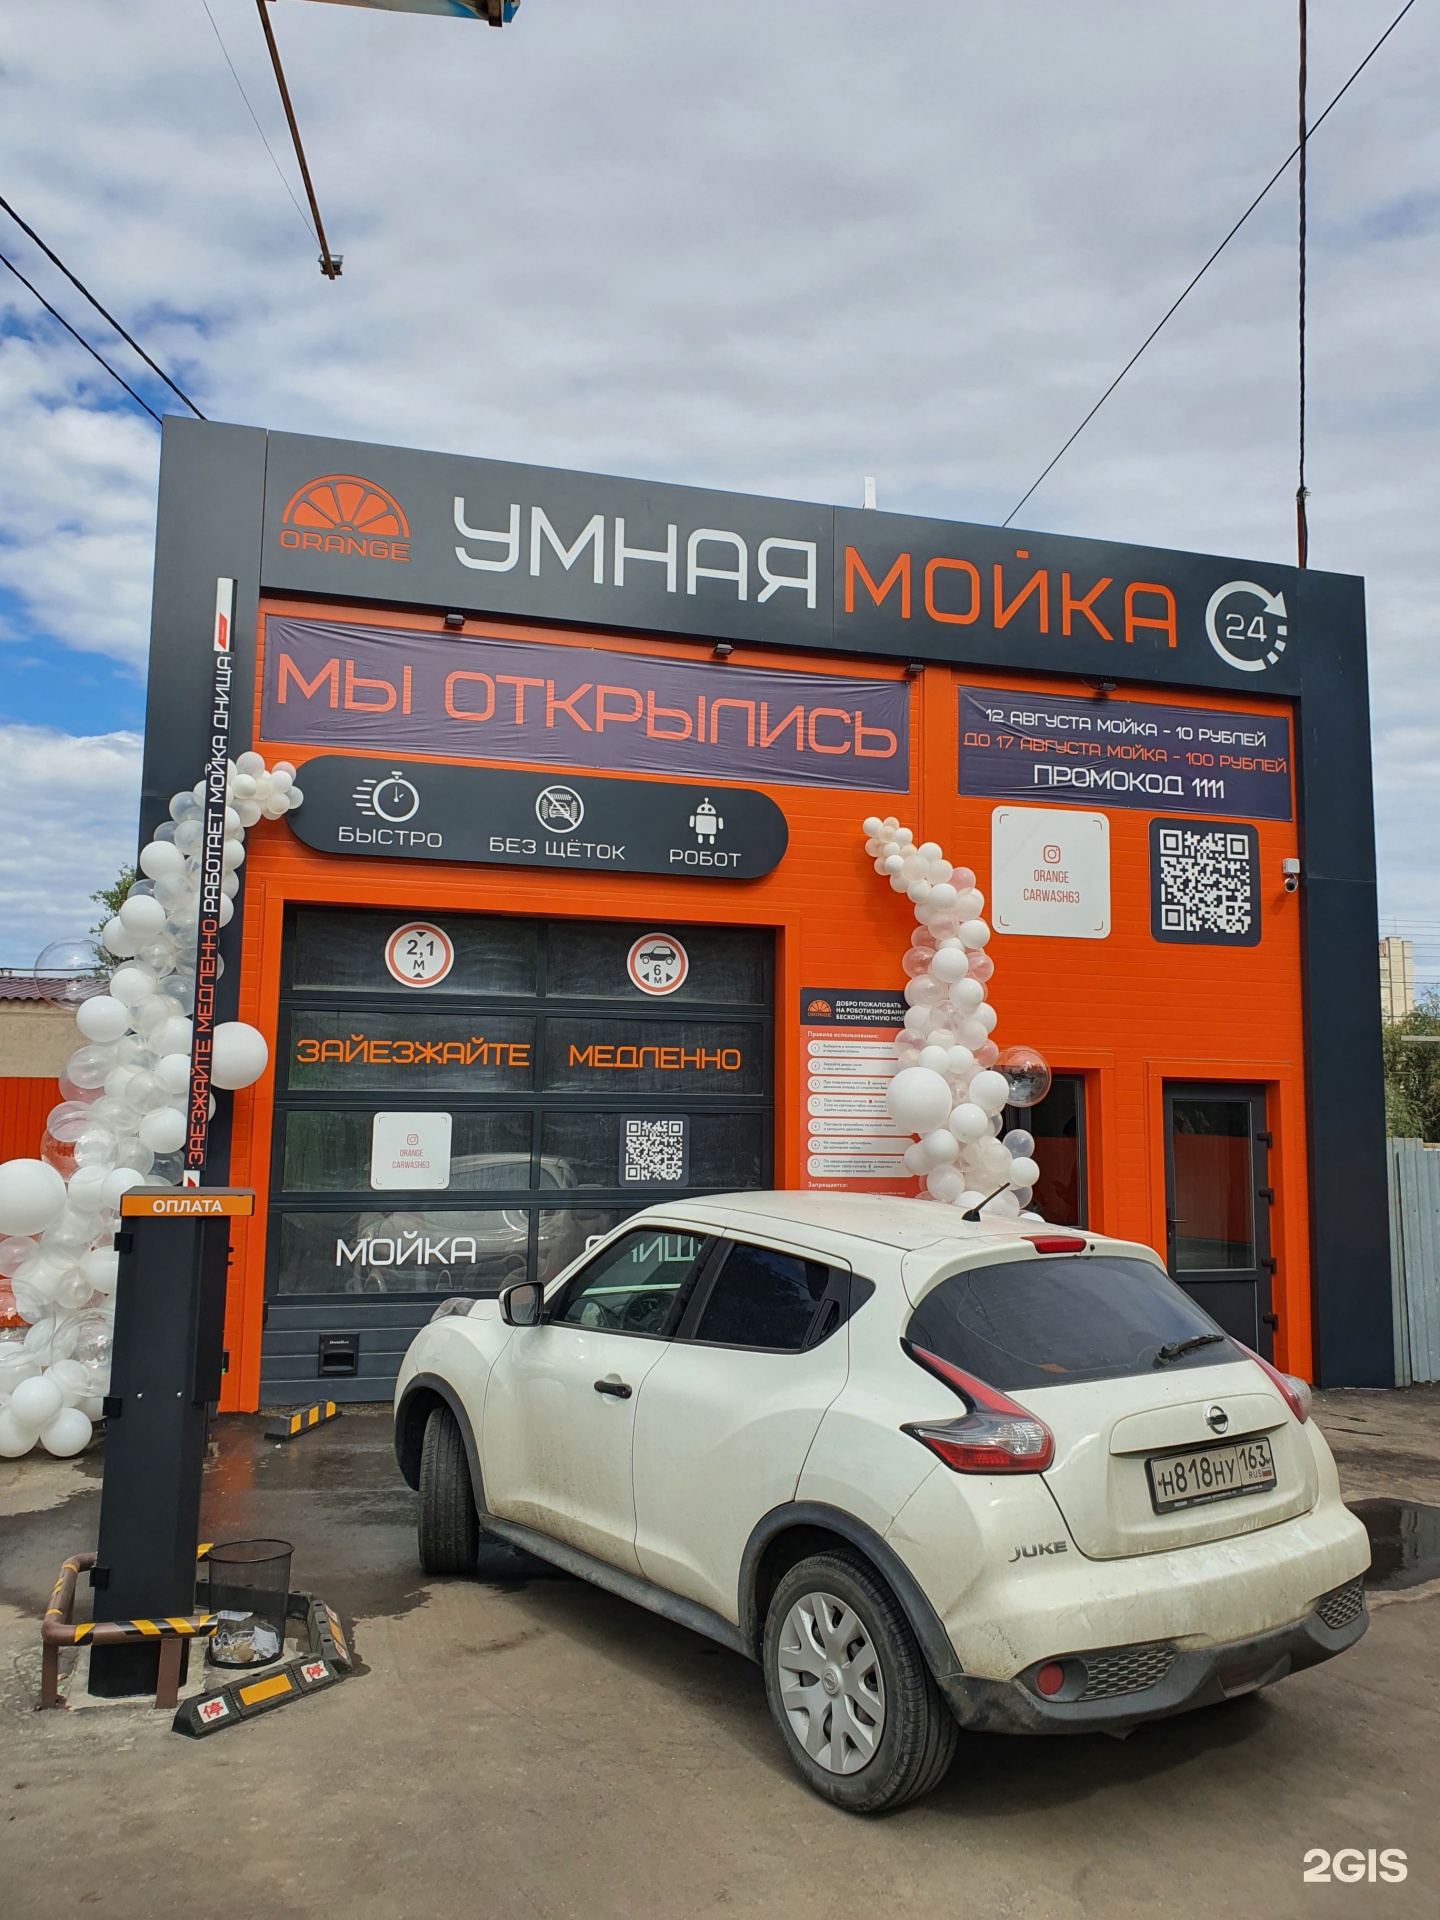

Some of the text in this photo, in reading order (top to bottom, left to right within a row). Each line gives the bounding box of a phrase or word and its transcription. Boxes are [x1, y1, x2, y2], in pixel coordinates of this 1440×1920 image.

[280, 529, 411, 562] ORANGE
[454, 496, 1178, 648] УМНАЯ МОЙКА
[1225, 613, 1267, 642] 24
[277, 653, 898, 758] МЫ ОТКРЫЛИСЬ
[985, 709, 1004, 723] 12
[1010, 711, 1091, 731] АВГУСТА
[1097, 718, 1157, 736] МОЙКА
[1176, 726, 1193, 740] 10
[1199, 728, 1266, 747] РУБЛЕЙ
[963, 732, 990, 747] ДО
[996, 735, 1014, 749] 17
[1020, 737, 1101, 757] АВГУСТА
[1107, 744, 1167, 762] МОЙКА
[1185, 752, 1214, 767] 100
[1219, 756, 1287, 774] РУБЛЕЙ
[1034, 764, 1225, 799] ПРОМОКОД 1111
[338, 826, 443, 848] БЫСТРО
[489, 837, 626, 861] БЕЗ ЩЁТОК
[669, 849, 742, 868] РОБОТ
[1033, 869, 1070, 884] ORANGE
[1023, 888, 1080, 904] CARWASH63
[188, 653, 232, 1165] ЗАЕЗЖАЙТЕ МЕДЛЕННО РАБОТАЕТ МОЙКА ДНИЩА
[406, 939, 434, 958] 2,1
[413, 960, 425, 970] М
[653, 964, 662, 976] 6
[653, 976, 662, 984] М
[297, 1035, 741, 1070] ЗАЙЕЗЖАЙТЕ МЕДЛЕННО
[399, 1148, 424, 1157] ORANGE
[392, 1160, 430, 1169] CARWASH63
[153, 1200, 223, 1214] ОПЛАТА
[336, 1230, 476, 1267] МОЙКА
[1161, 1457, 1235, 1497] Н818НУ
[1239, 1444, 1267, 1472] 163
[1248, 1469, 1263, 1479] RUS
[1007, 1540, 1068, 1563] JUKE
[203, 1700, 224, 1719] 停
